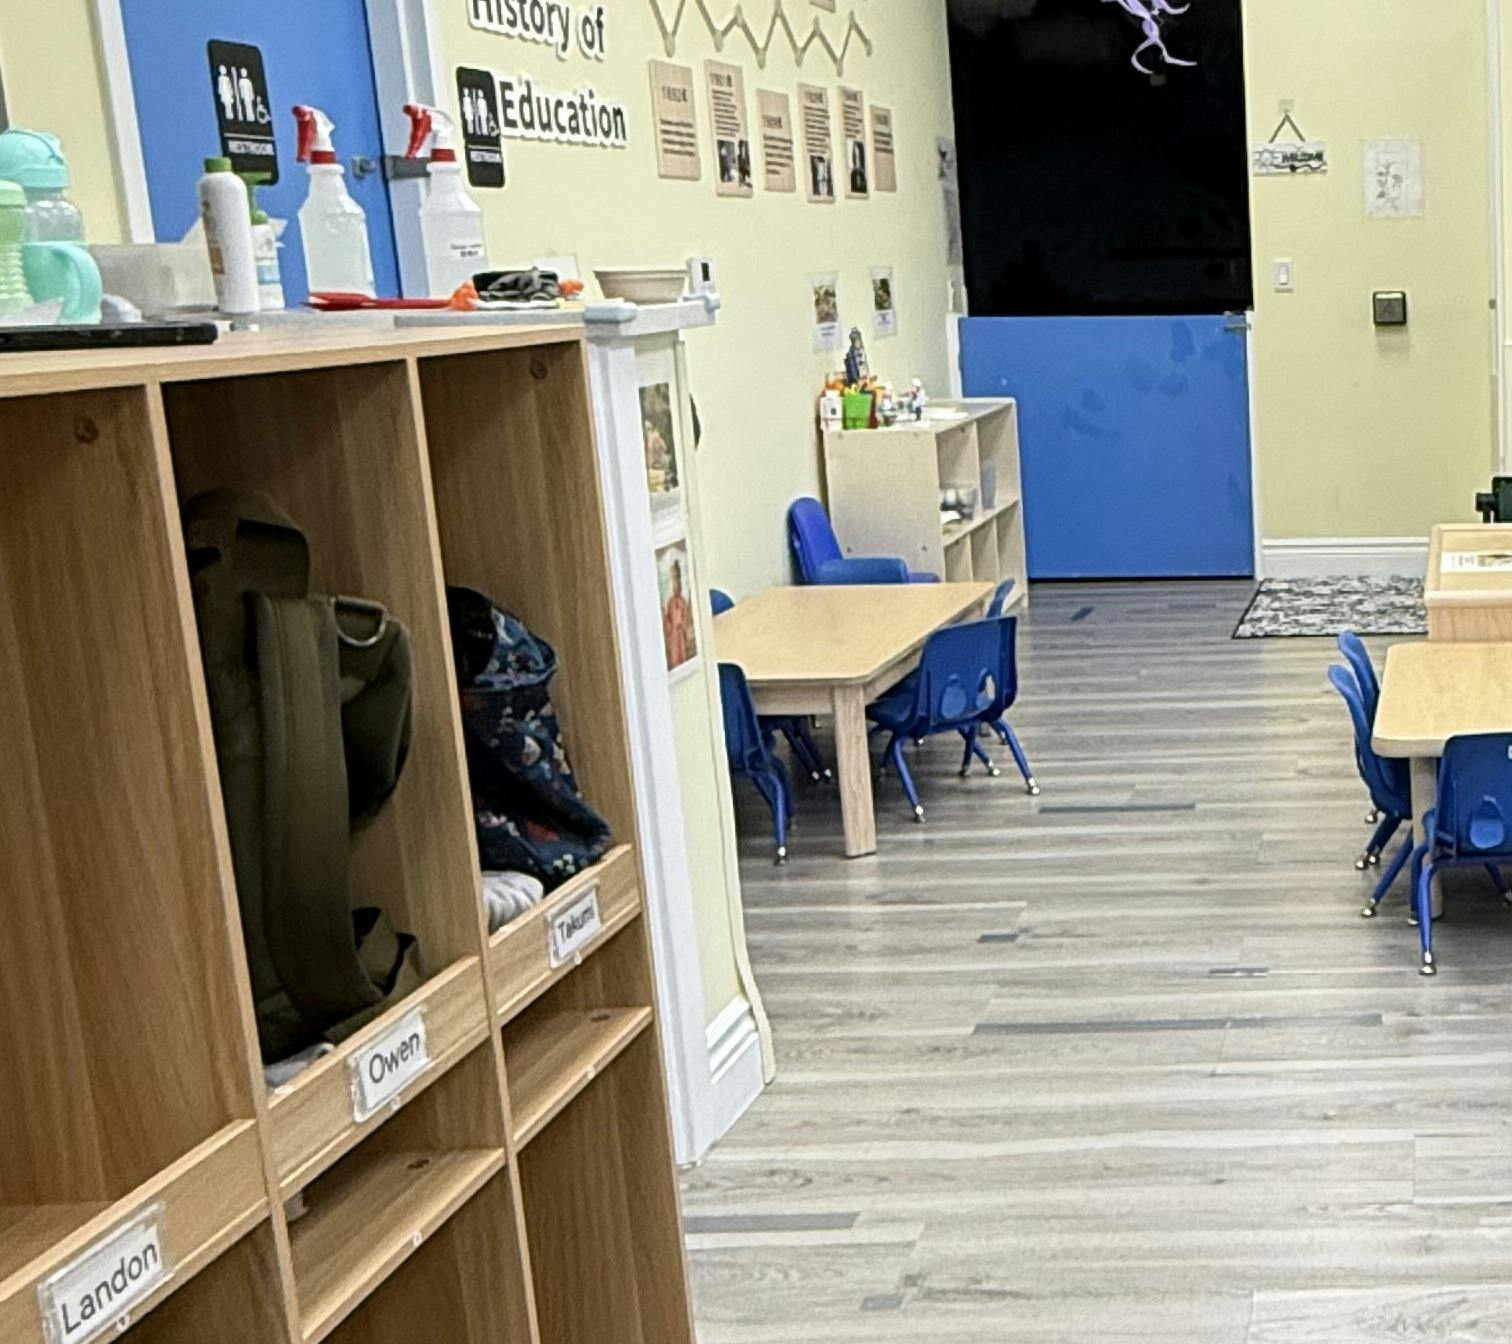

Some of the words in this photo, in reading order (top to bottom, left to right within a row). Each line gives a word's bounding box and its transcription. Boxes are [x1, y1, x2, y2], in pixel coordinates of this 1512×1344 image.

[581, 6, 606, 53] of
[498, 79, 628, 141] Education
[368, 1032, 420, 1084] Owen
[60, 1242, 158, 1336] Landon
